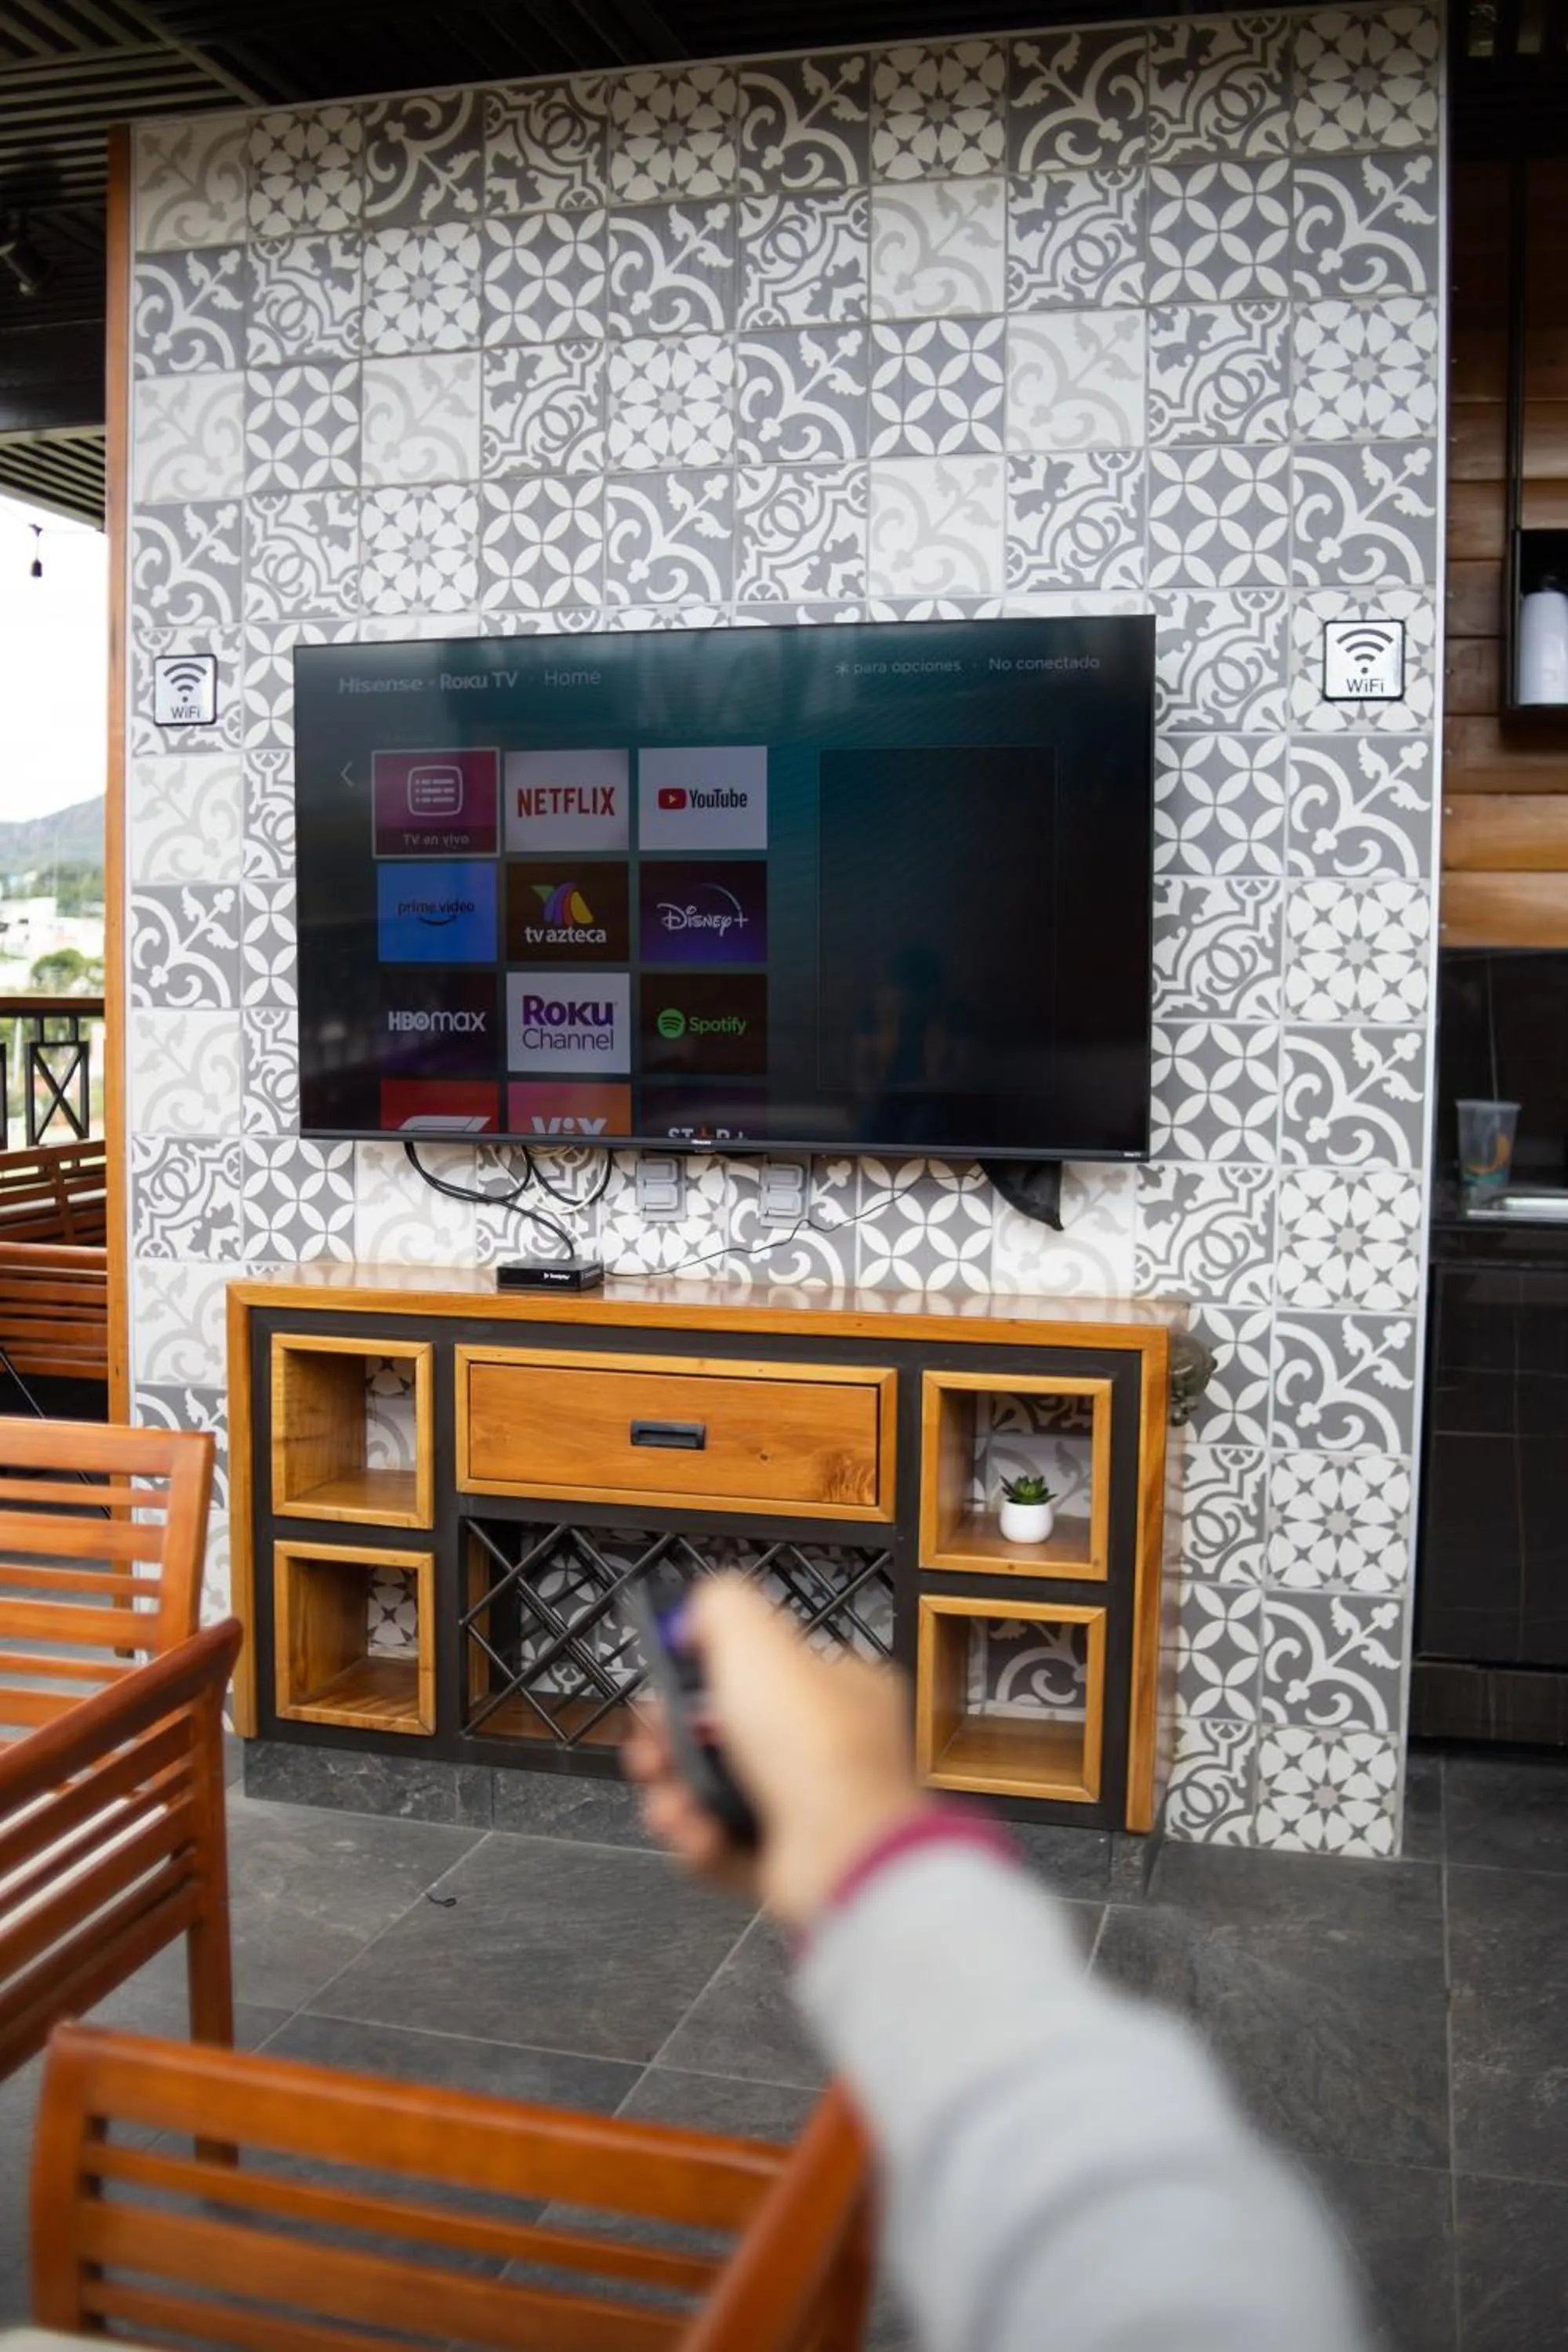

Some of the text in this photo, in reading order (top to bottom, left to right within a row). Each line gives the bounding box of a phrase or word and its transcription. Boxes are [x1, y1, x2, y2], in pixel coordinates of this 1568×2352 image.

[853, 659, 963, 676] para opciones
[989, 653, 1101, 670] No conectado
[339, 669, 602, 694] Hisense Roku TV Home
[1345, 677, 1385, 693] WiFi
[517, 786, 615, 817] NETFLIX
[689, 789, 748, 809] YouTube
[402, 833, 470, 845] TV en vivo
[397, 899, 475, 915] prime video
[689, 1017, 746, 1035] Spotify
[522, 1029, 613, 1050] Channel
